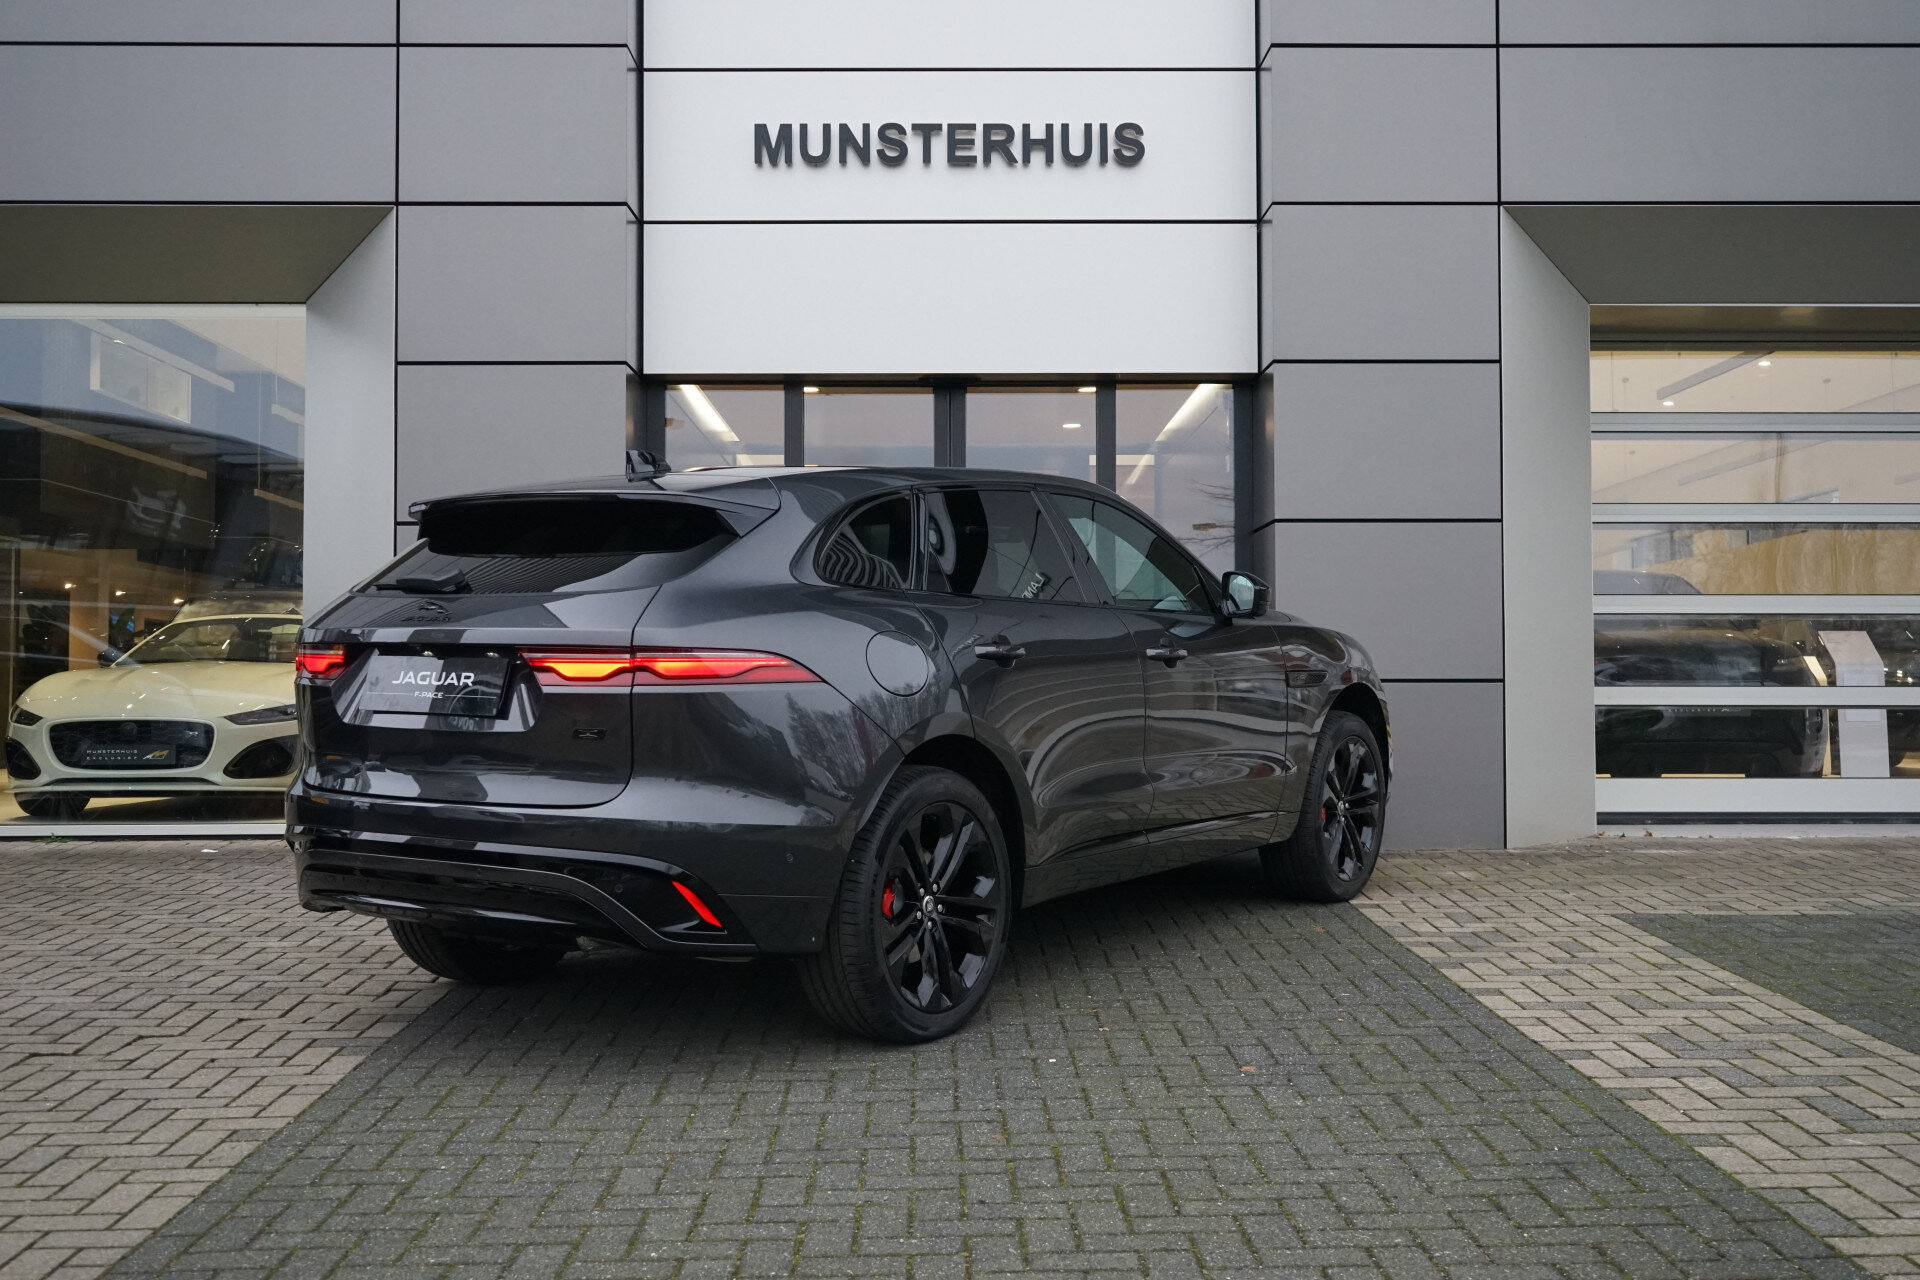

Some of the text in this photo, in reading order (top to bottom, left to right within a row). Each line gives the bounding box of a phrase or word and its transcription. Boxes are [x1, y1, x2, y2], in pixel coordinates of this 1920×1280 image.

[753, 121, 1146, 167] MUNSTERHUIS
[391, 670, 475, 687] JAGUAR
[413, 691, 444, 699] F-PACE
